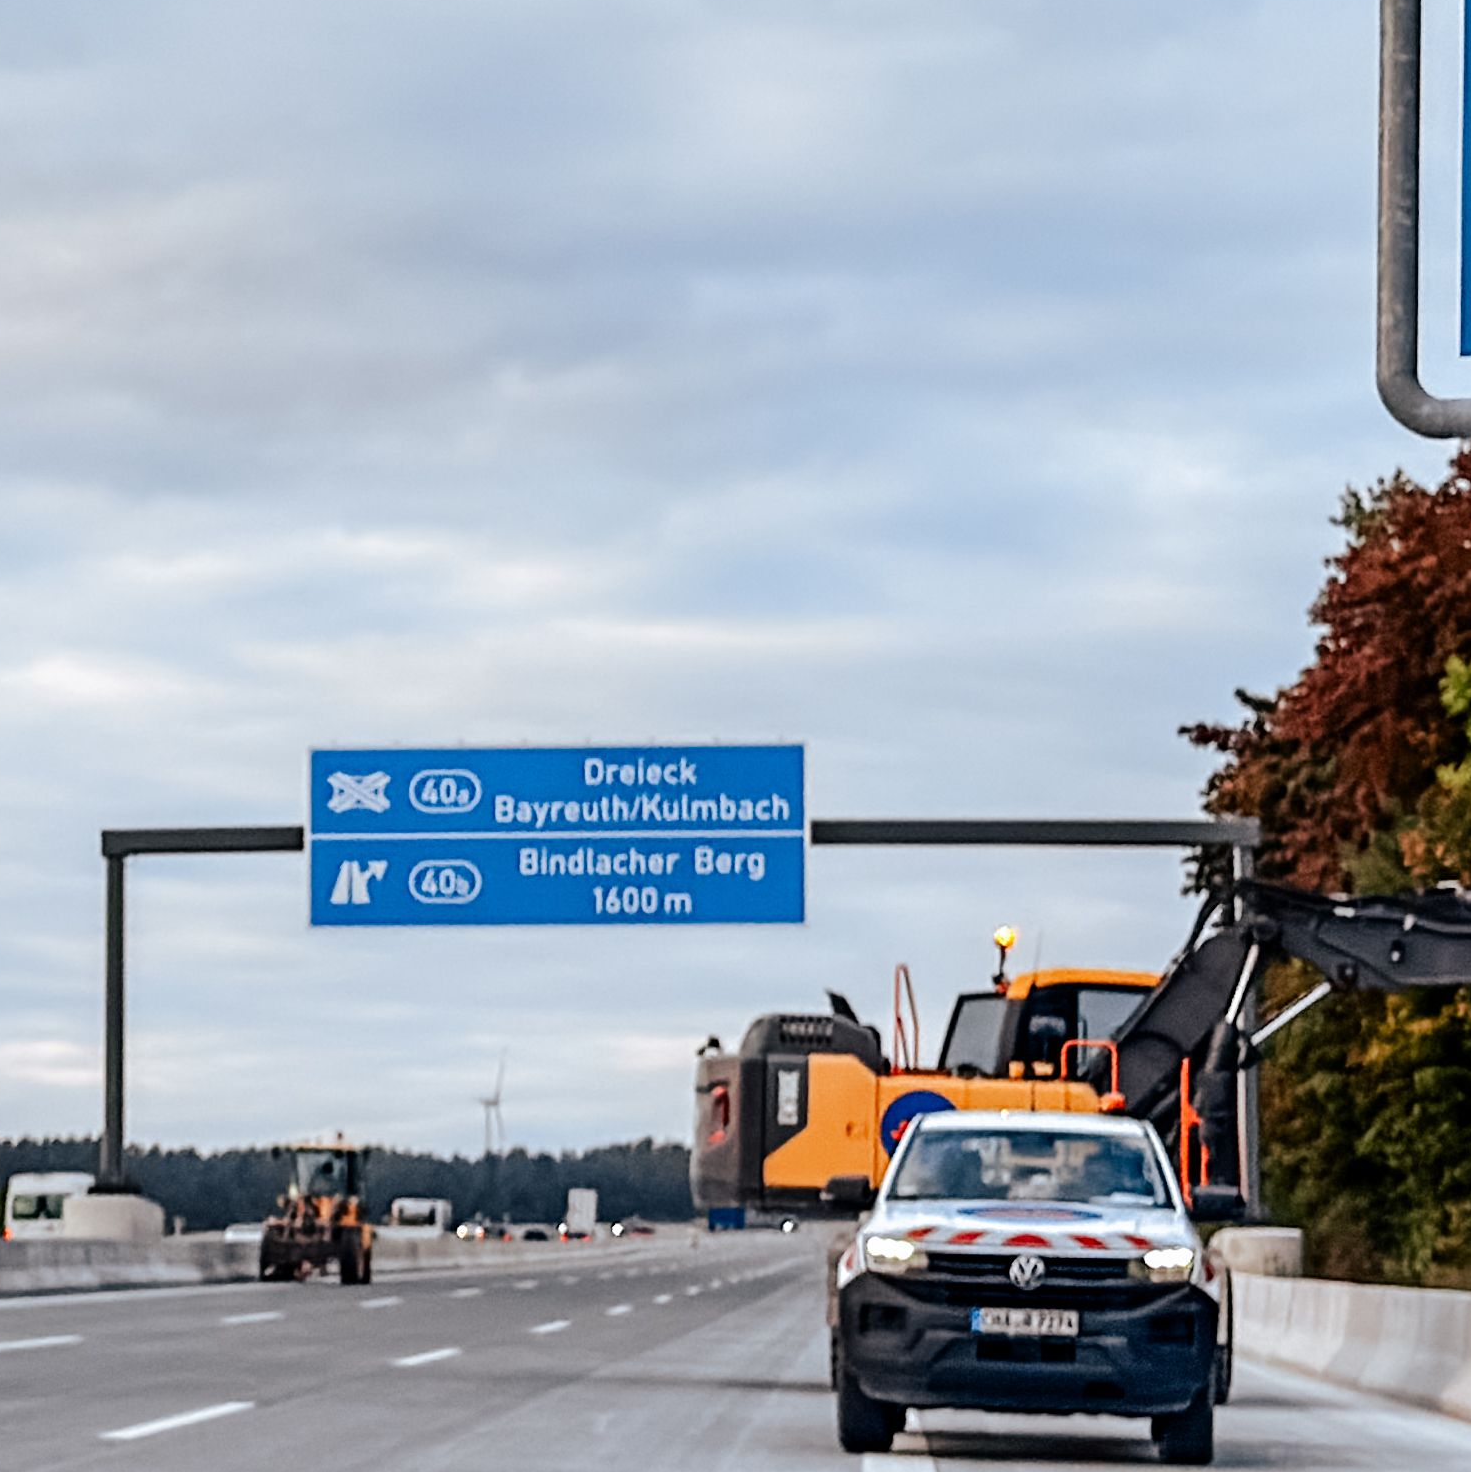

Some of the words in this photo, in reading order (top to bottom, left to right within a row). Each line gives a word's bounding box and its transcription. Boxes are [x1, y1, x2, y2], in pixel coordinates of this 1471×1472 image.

[584, 757, 697, 786] Dreieck
[494, 793, 790, 828] Bayreuth/Kulmbach
[519, 847, 680, 876] Bindlacher
[694, 845, 765, 881] Berg
[593, 885, 658, 914] 1600
[663, 892, 693, 914] m
